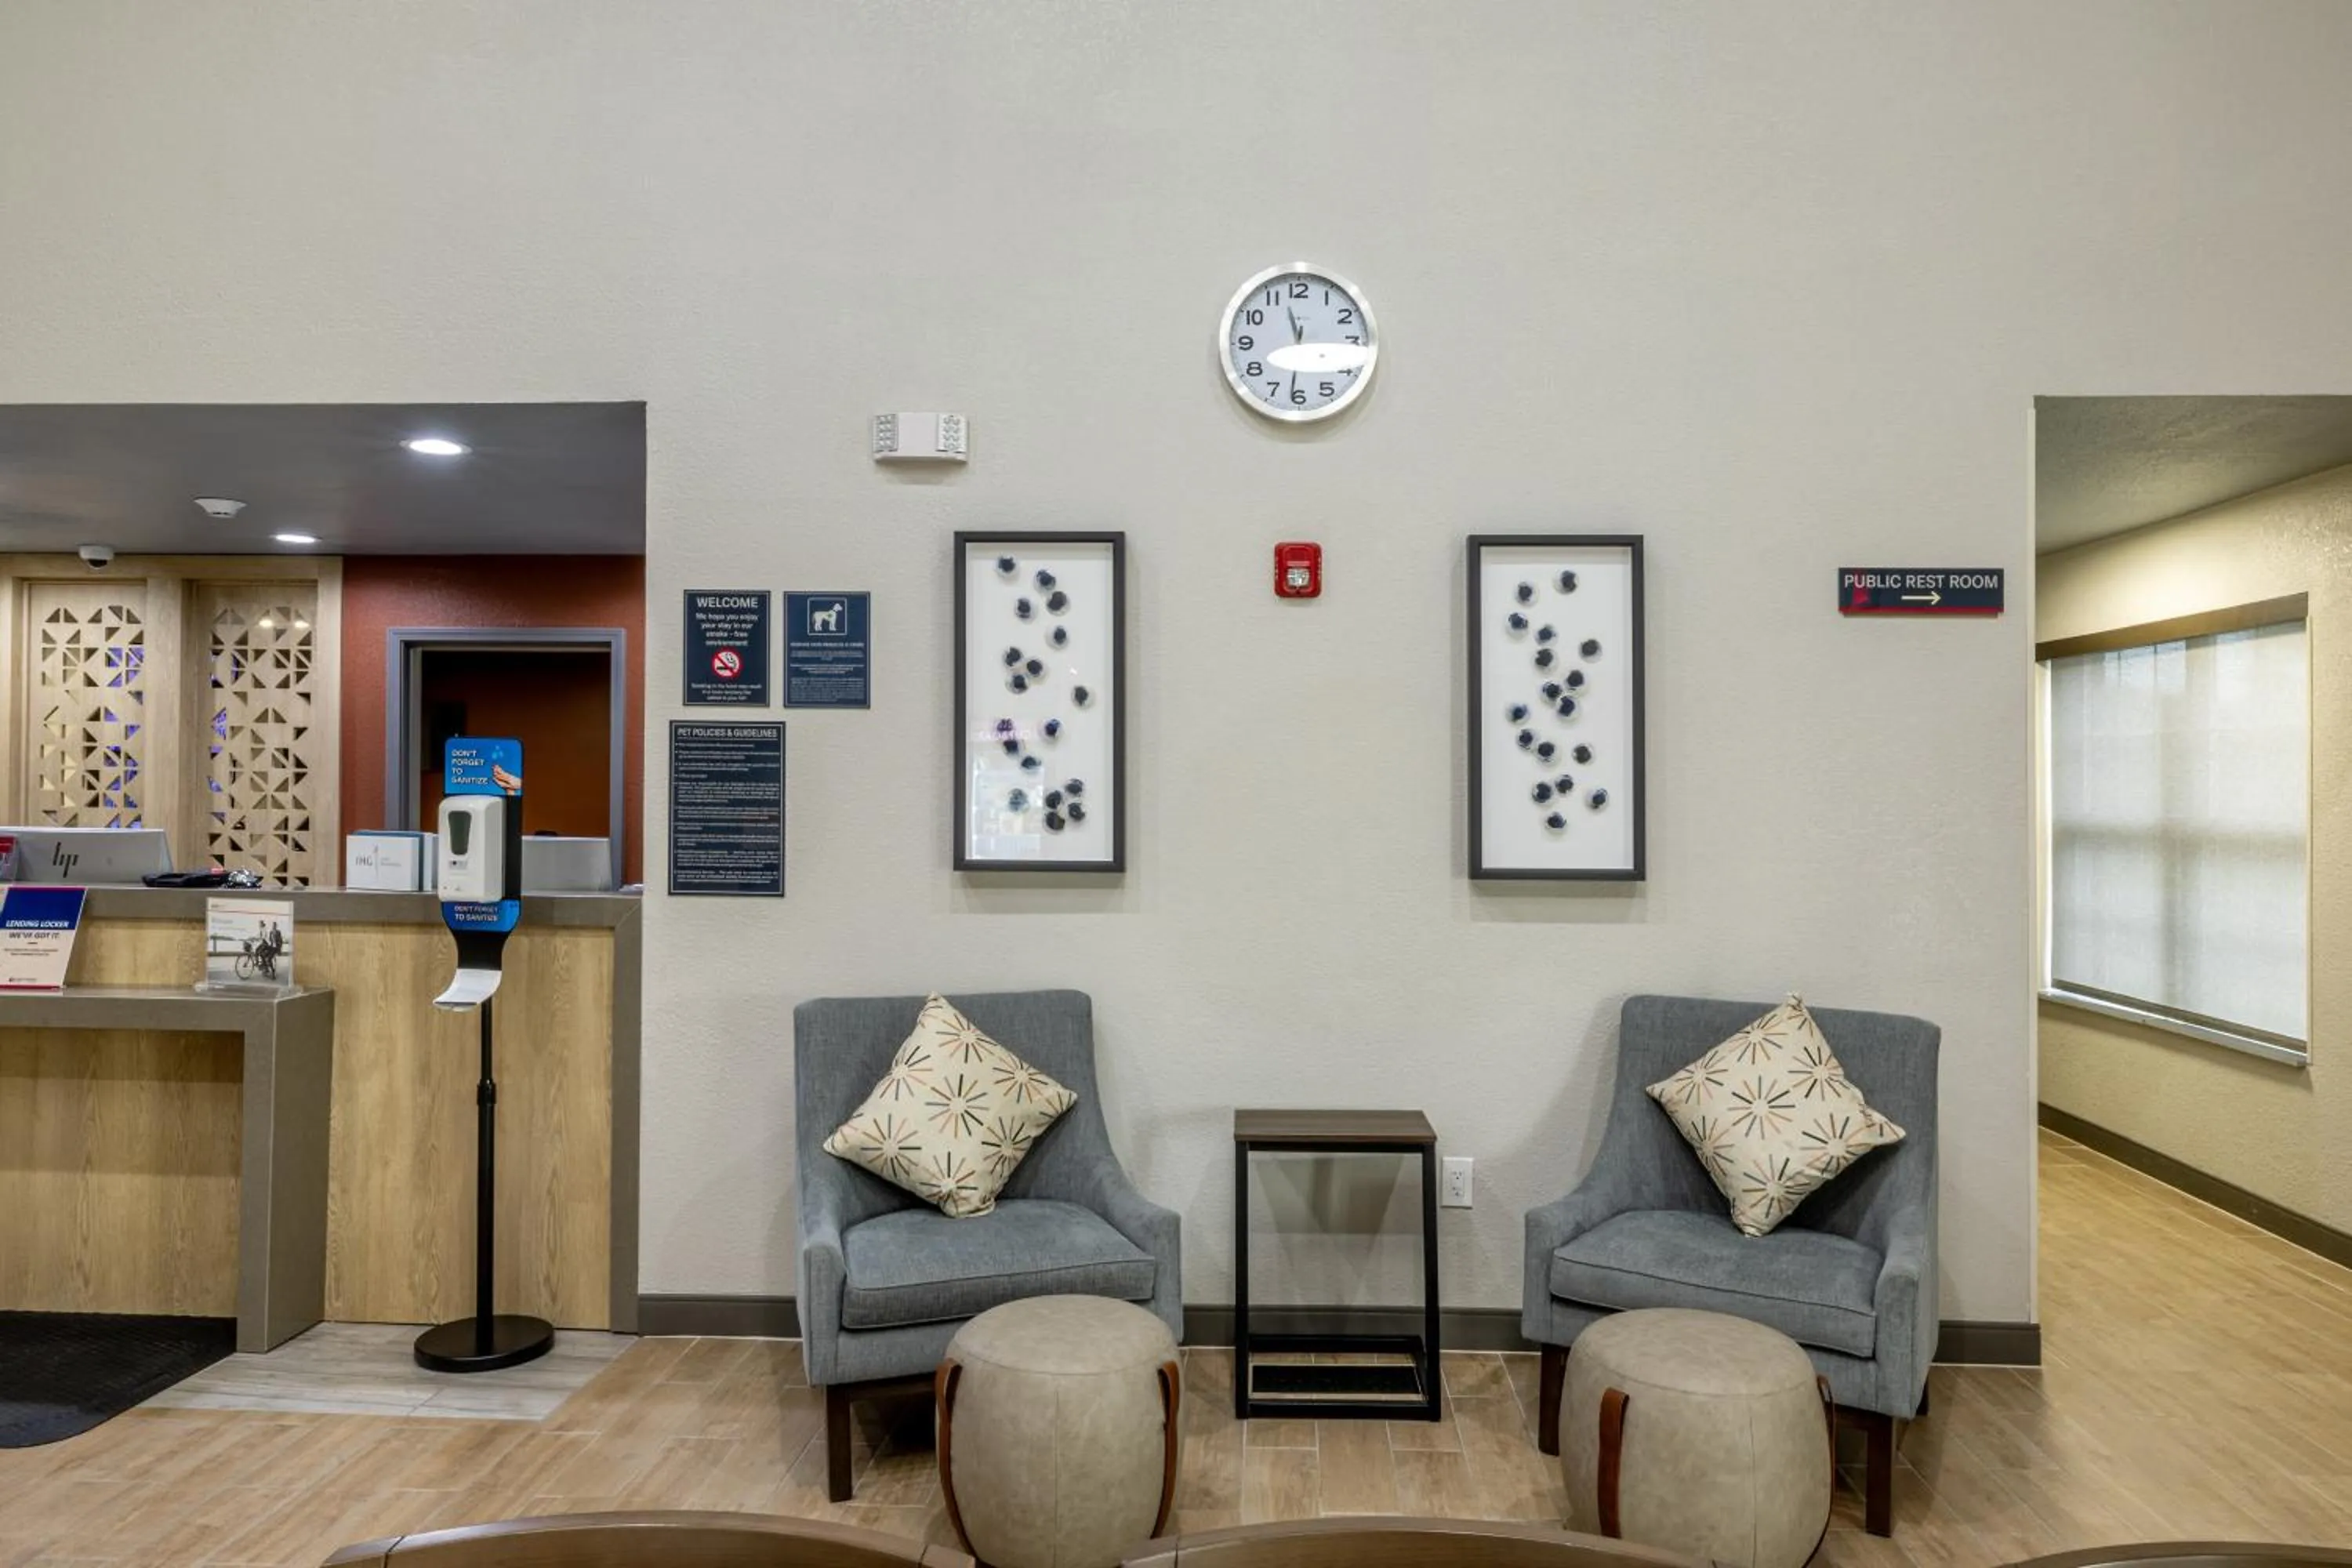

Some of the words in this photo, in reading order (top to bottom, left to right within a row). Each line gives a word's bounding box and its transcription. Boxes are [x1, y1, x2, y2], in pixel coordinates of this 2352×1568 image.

[1266, 290, 1279, 306] 11
[1289, 283, 1308, 299] 12
[1324, 290, 1329, 306] 1
[1246, 309, 1263, 325] 10
[1337, 308, 1352, 325] 2
[1238, 335, 1254, 350] 9
[1246, 361, 1263, 377] 8
[1266, 382, 1280, 397] 7
[1319, 382, 1334, 397] 5
[1291, 390, 1306, 405] 6
[1844, 575, 1901, 588] PUBLIC
[1906, 575, 1945, 588] REST
[1949, 575, 1998, 588] ROOM
[696, 597, 759, 608] WELCOME
[708, 613, 725, 622] hope
[677, 727, 691, 736] PET
[692, 728, 726, 737] POLICIES
[727, 728, 732, 737] &
[733, 728, 777, 738] GUIDELINES
[53, 841, 79, 878] hp
